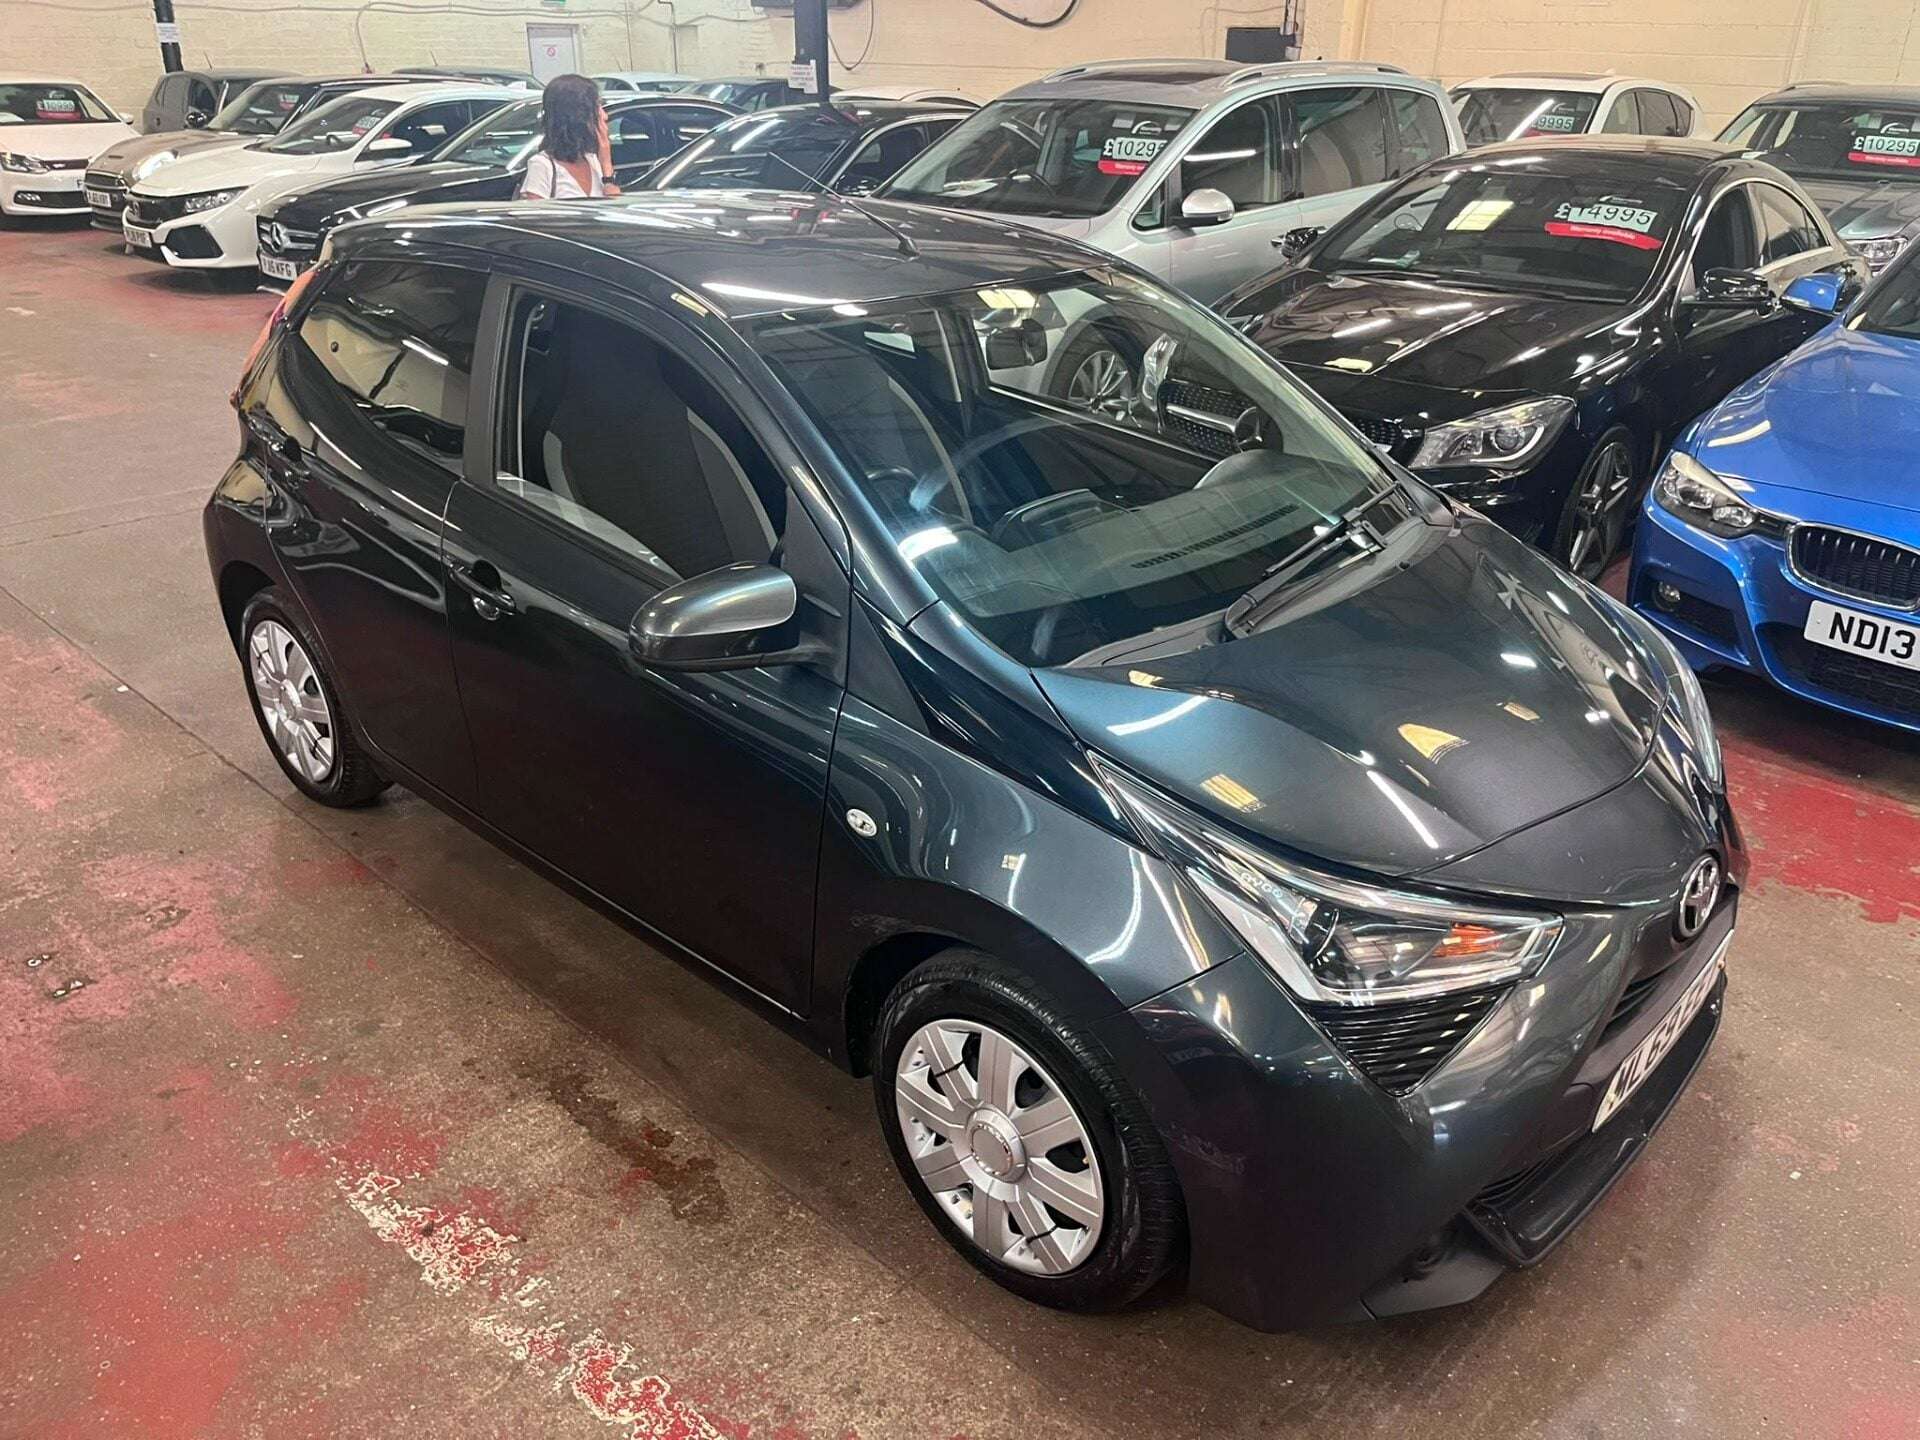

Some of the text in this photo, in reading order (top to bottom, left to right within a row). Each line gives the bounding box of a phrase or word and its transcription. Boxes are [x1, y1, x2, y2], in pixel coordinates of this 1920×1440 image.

[1853, 136, 1917, 153] £10295
[1554, 202, 1651, 225] £14995
[1829, 611, 1916, 659] ND13
